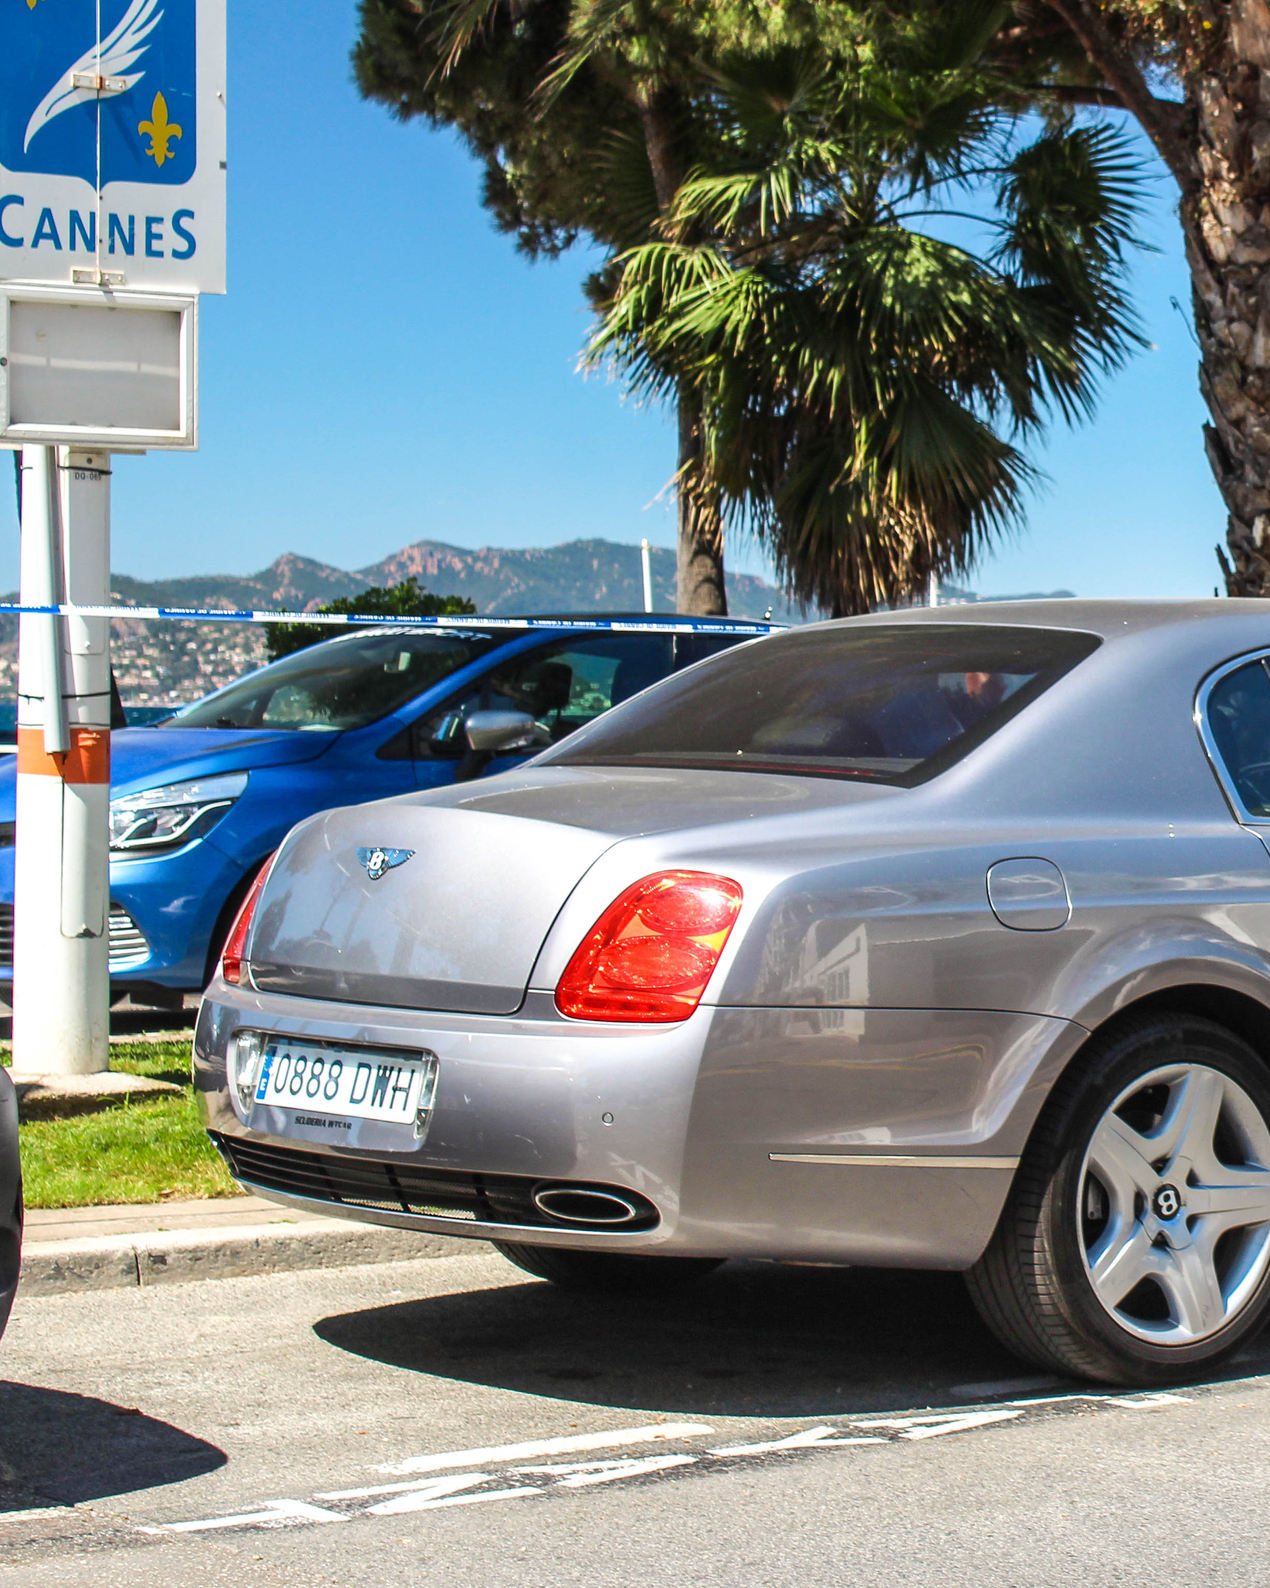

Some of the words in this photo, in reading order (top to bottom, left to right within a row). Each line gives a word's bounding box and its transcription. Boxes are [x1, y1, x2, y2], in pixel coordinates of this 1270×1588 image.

[0, 194, 196, 260] CANNES
[274, 1053, 343, 1100] 0888
[349, 1062, 416, 1112] DWH
